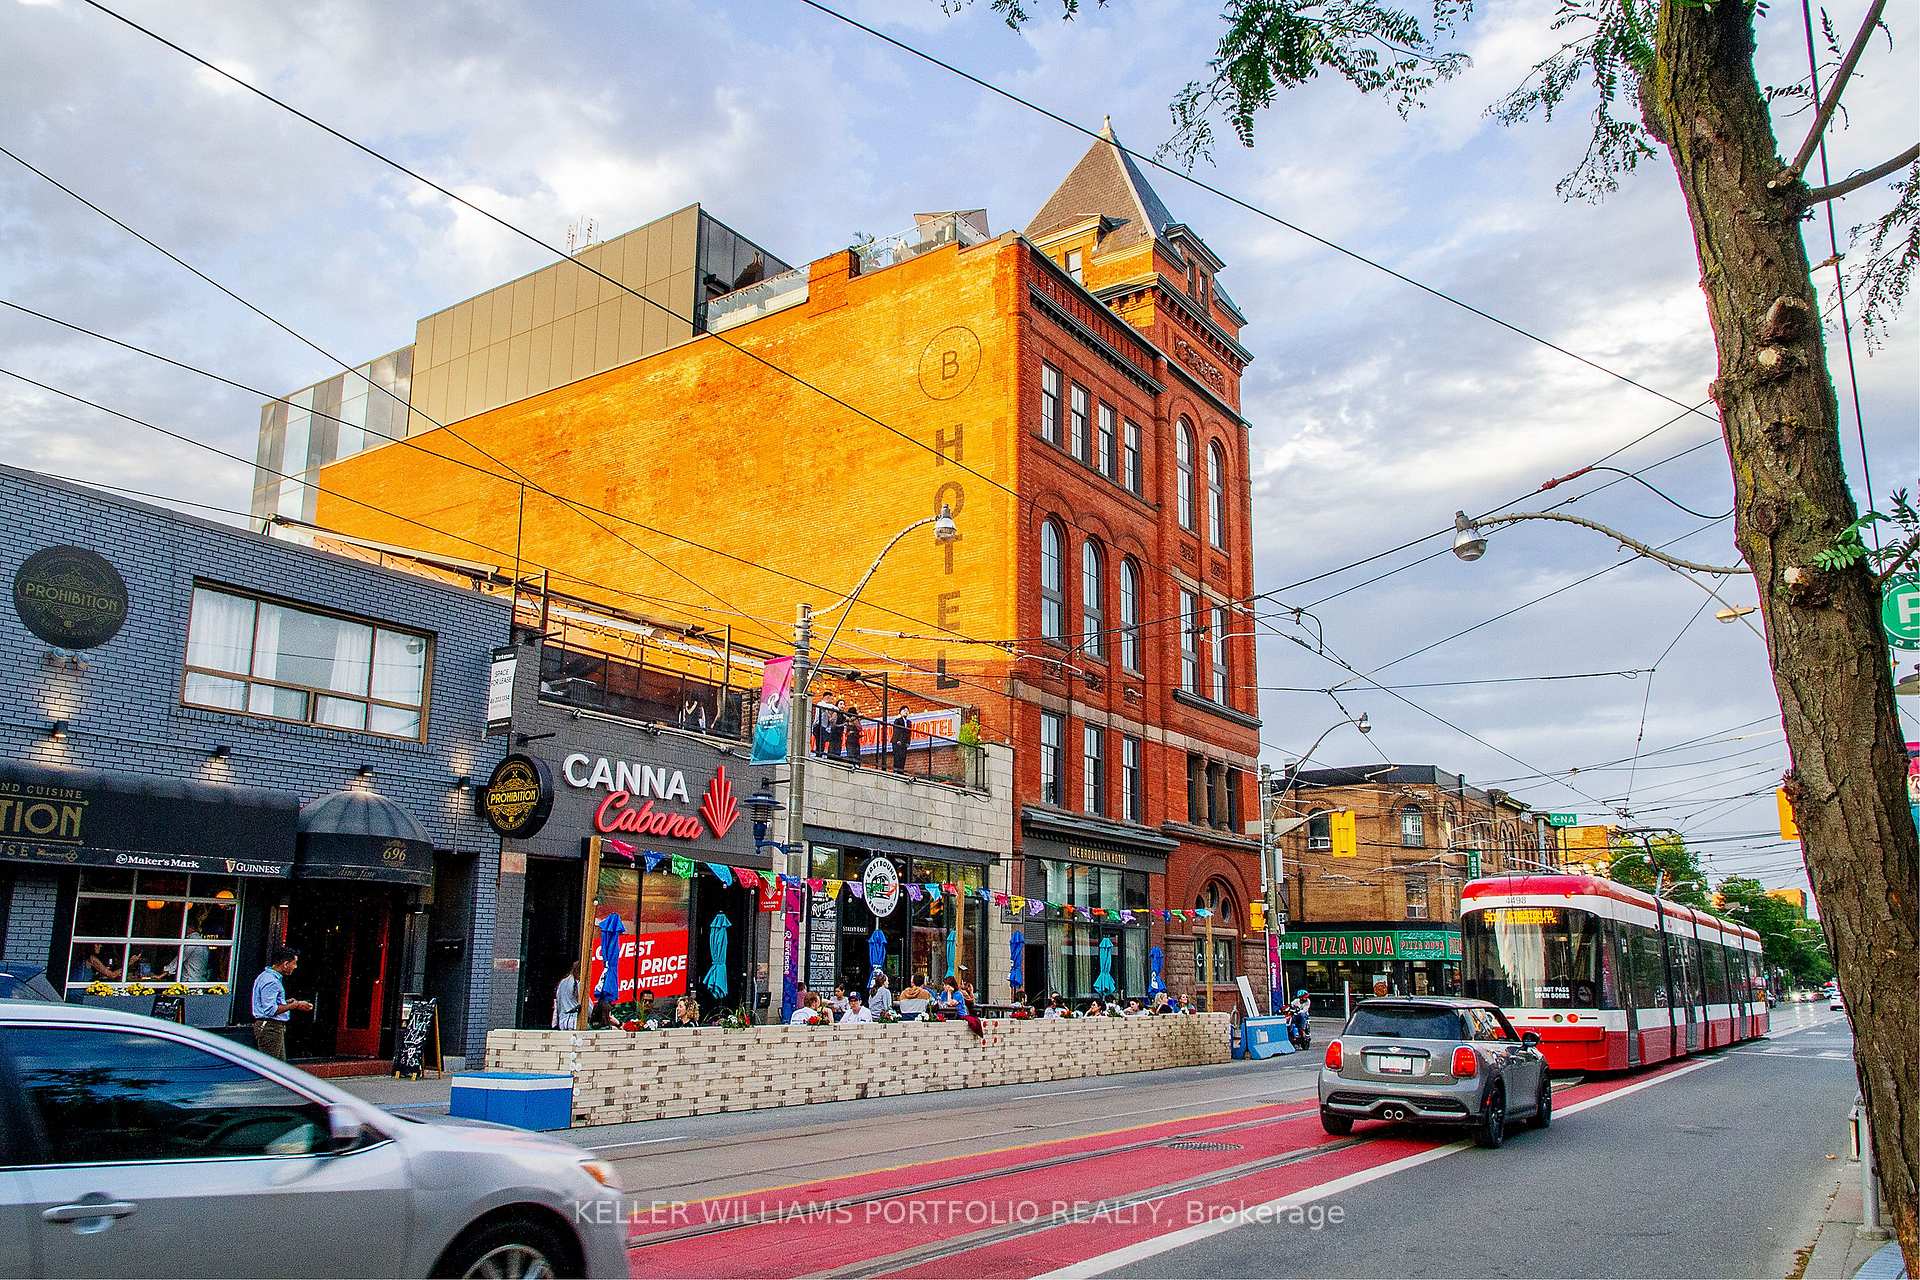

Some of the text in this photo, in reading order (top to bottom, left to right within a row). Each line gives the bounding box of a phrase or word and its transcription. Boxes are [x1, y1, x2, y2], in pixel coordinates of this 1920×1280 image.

[934, 424, 965, 690] HOTEL
[26, 582, 118, 611] PROHIBITION
[911, 718, 956, 740] HOTEL
[562, 753, 690, 803] CANNA
[26, 784, 83, 799] CUISINE
[490, 789, 536, 804] PROHIBITION
[0, 799, 83, 837] TION
[594, 790, 704, 840] Cabana
[1560, 815, 1575, 823] NA
[0, 844, 30, 857] SE
[383, 847, 406, 861] 696
[1069, 846, 1080, 858] THE
[1111, 852, 1127, 865] HOTEL
[127, 855, 170, 867] Maker's
[171, 859, 200, 868] Mark
[236, 862, 281, 874] GUINNESS
[867, 860, 897, 880] EASTBOUND
[1506, 896, 1527, 904] 4498
[592, 940, 655, 961] OEST
[1301, 936, 1348, 955] PIZZA
[1353, 935, 1394, 955] NOVA
[1400, 940, 1423, 950] PIZZA
[1424, 940, 1445, 951] NOVA
[640, 955, 688, 974] PRICE
[618, 972, 679, 991] RANTEED
